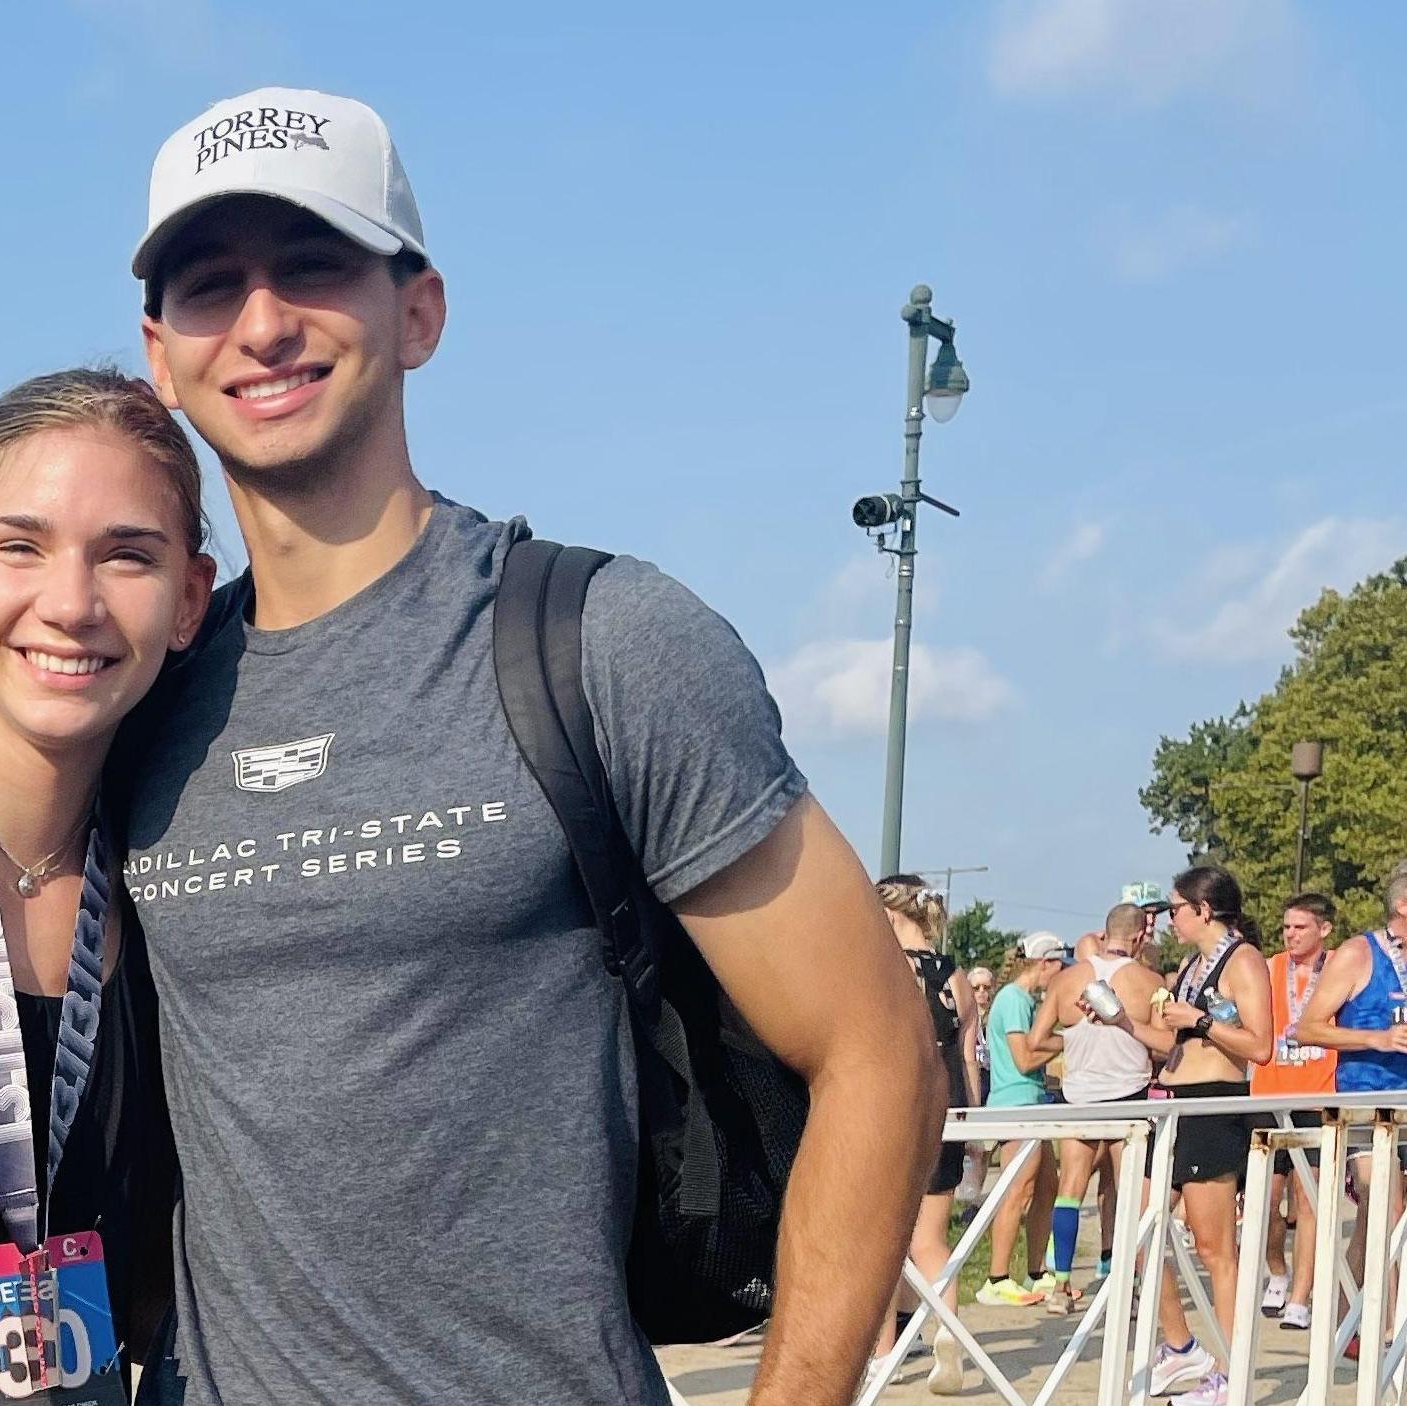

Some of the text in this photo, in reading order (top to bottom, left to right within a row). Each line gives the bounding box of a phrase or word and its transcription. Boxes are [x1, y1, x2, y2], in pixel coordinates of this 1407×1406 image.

[194, 107, 332, 151] TORREY
[194, 128, 288, 175] PINES
[276, 801, 506, 852] TRI-STATE
[301, 838, 462, 878] SERIES
[63, 1237, 77, 1256] C
